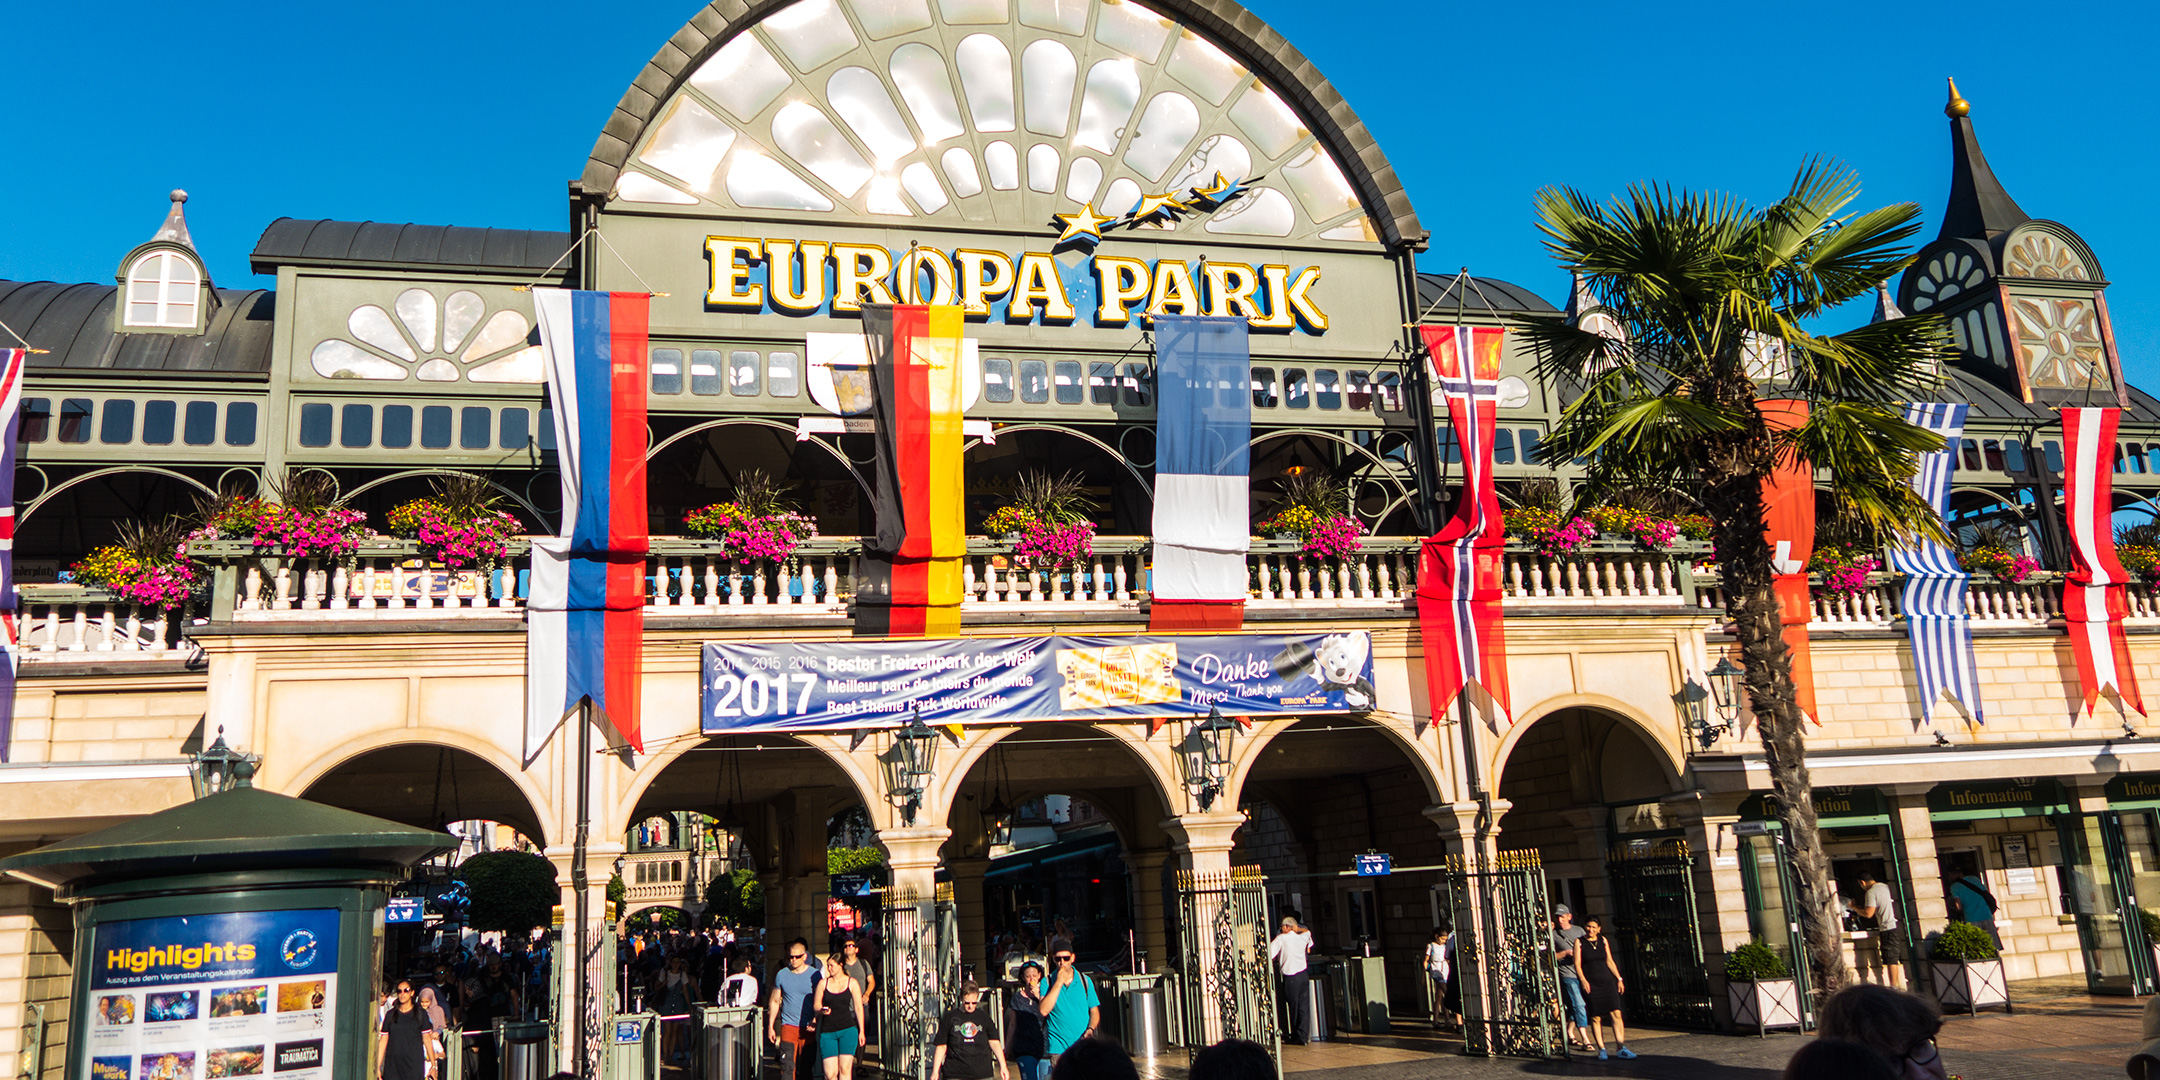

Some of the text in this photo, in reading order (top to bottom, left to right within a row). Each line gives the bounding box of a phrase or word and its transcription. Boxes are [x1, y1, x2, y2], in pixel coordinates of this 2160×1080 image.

[705, 234, 1329, 330] EUROPA PARK
[713, 656, 818, 671] 2014 2015 2016
[826, 650, 1036, 673] Bester Freizeitpark der Welt
[1191, 653, 1270, 685] Danke
[826, 674, 1034, 694] Meilleur parc de loisirs du monde
[713, 673, 818, 717] 2017
[826, 695, 1008, 714] Best Theme Park Worldwide
[1189, 683, 1284, 707] Merci Thank you
[1280, 696, 1328, 705] EUROPA PARK
[1948, 787, 2032, 806] Information
[2123, 781, 2160, 796] Infor
[1760, 797, 1851, 816] Ination
[107, 941, 257, 973] Highlights
[142, 974, 159, 982] dem
[160, 967, 255, 981] Veranstaltungskalender
[280, 1049, 319, 1065] TRAUMATICA
[93, 1062, 119, 1074] Music
